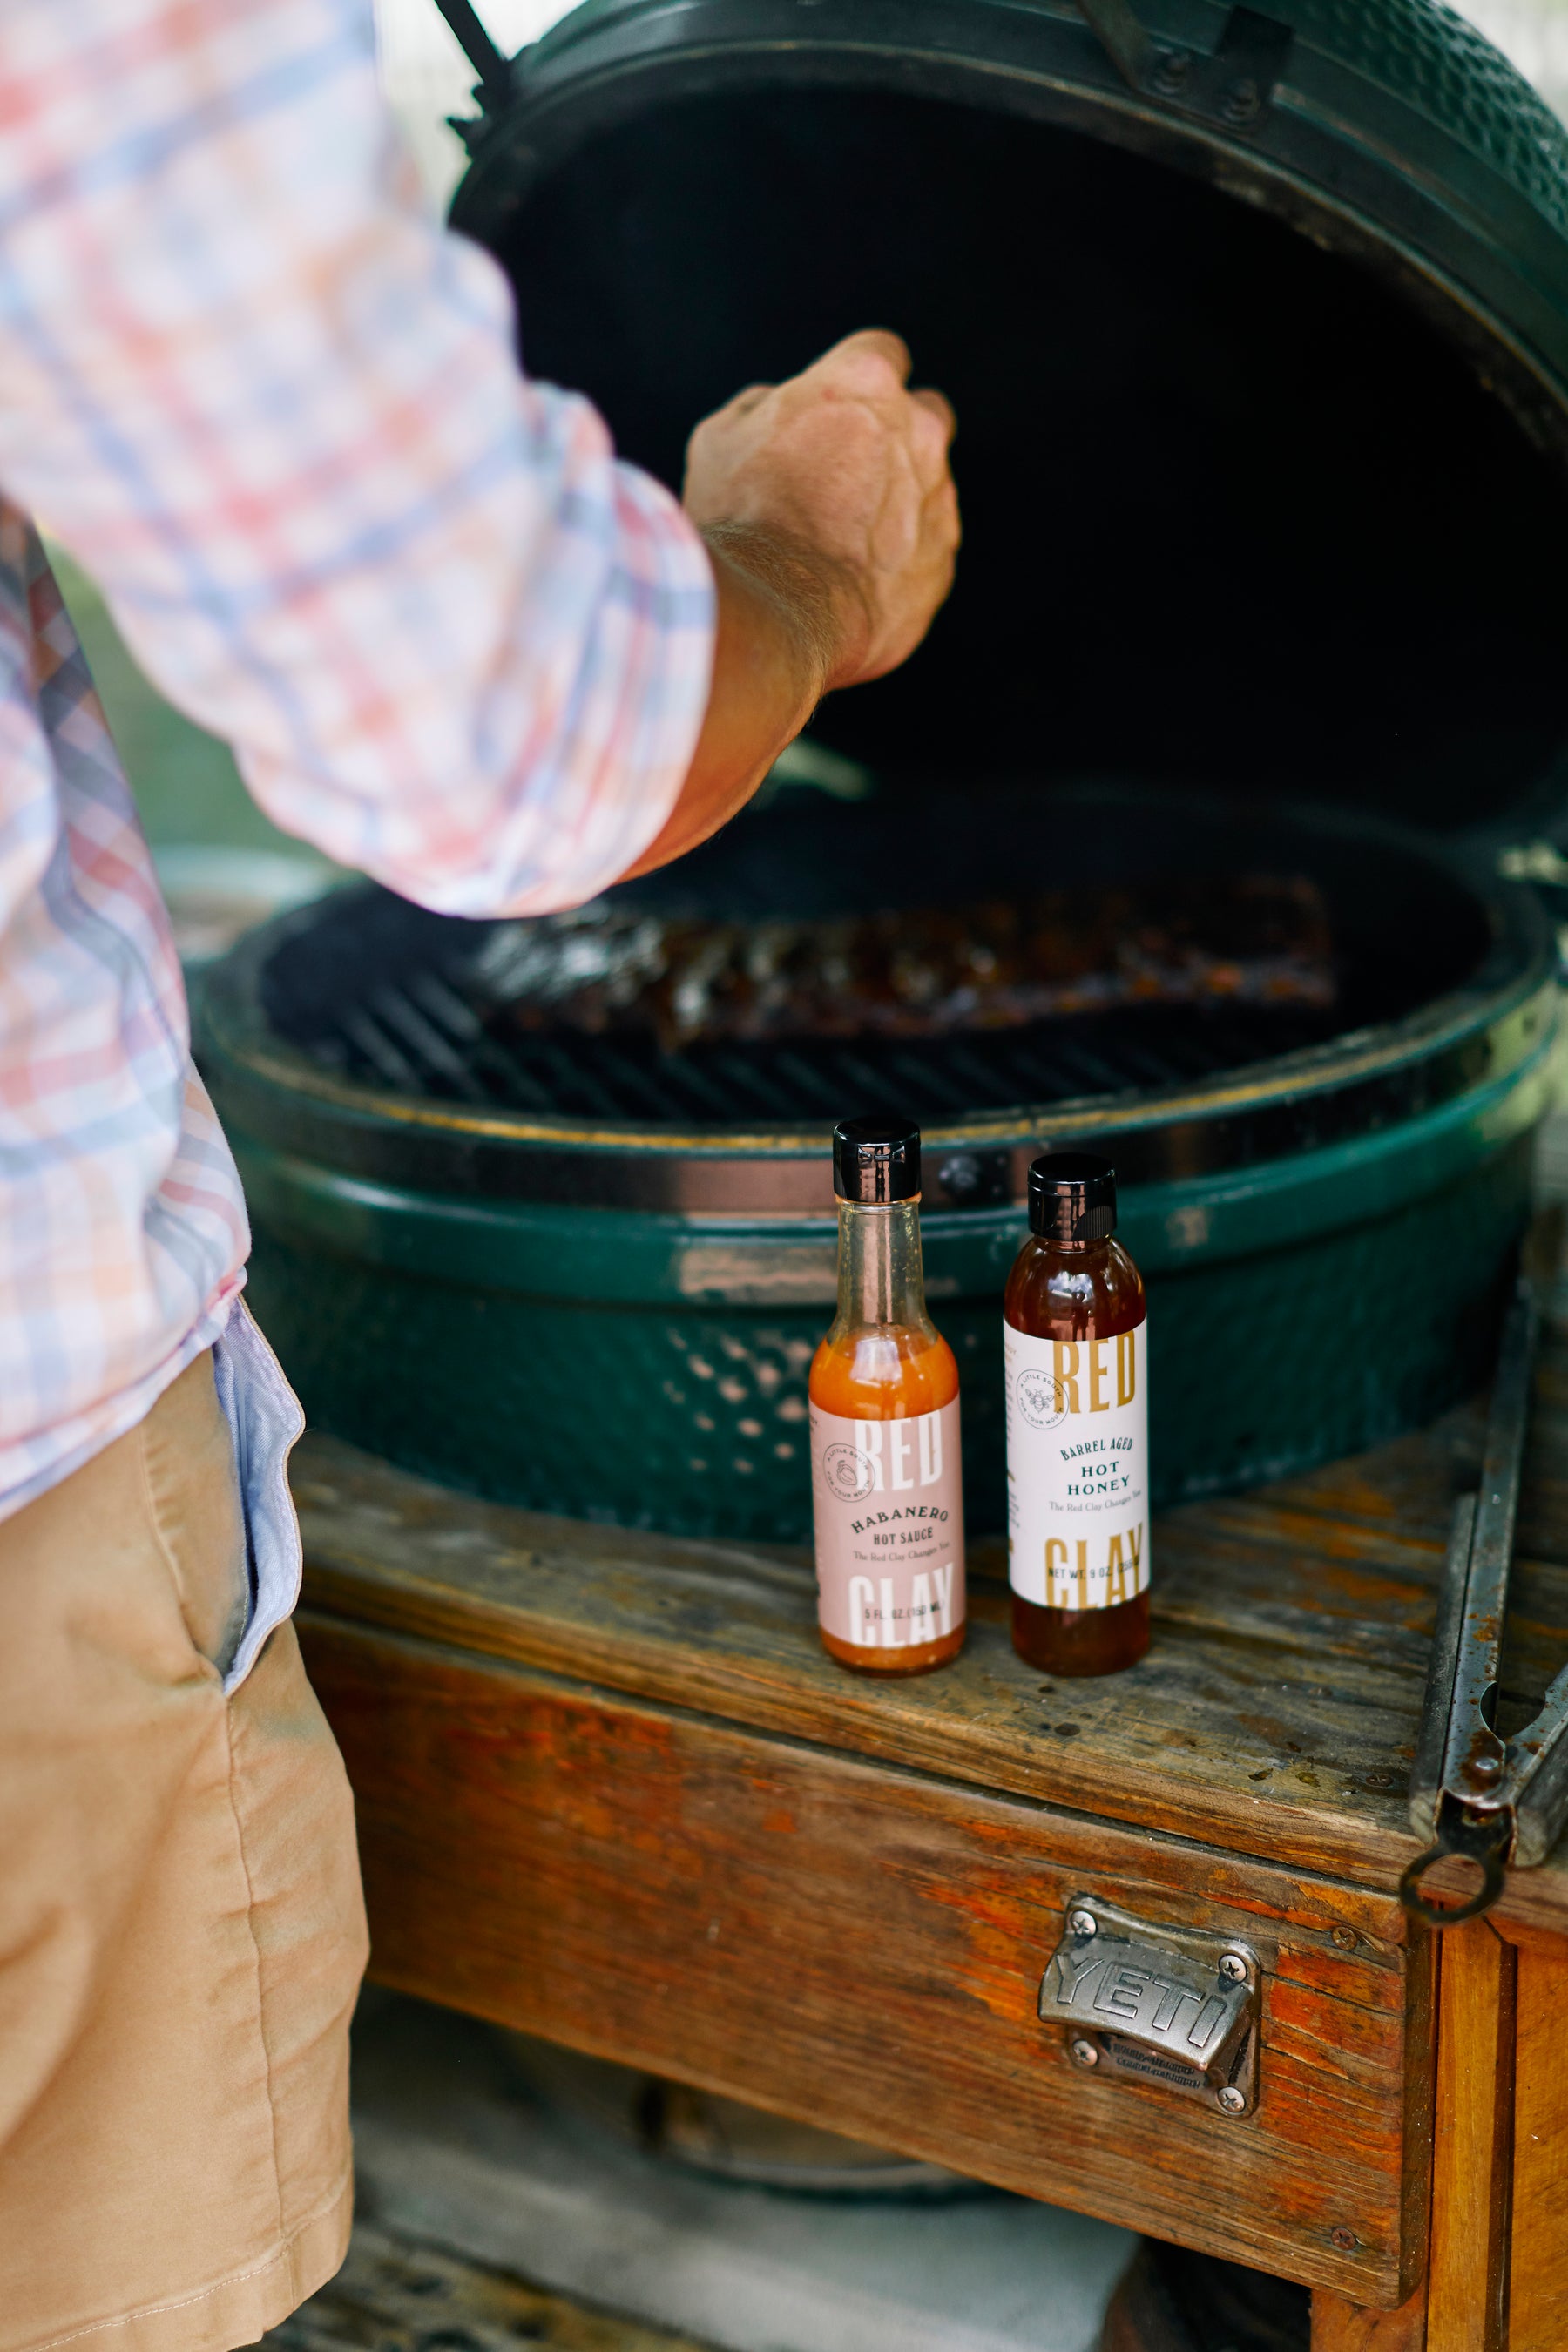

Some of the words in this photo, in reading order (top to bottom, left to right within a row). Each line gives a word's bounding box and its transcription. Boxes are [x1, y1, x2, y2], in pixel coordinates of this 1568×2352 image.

[1053, 1328, 1135, 1414] RED
[1023, 1374, 1040, 1383] LITTLE
[1043, 1377, 1062, 1396] SOUTH
[1028, 1414, 1044, 1425] YOUR
[1045, 1407, 1064, 1425] MOUTH
[830, 1448, 848, 1457] LITTLE
[849, 1450, 868, 1470] SOUTH
[855, 1409, 943, 1491] RED
[1060, 1438, 1106, 1461] BARREL
[1110, 1436, 1133, 1450] AGED
[1081, 1461, 1119, 1477] HOT
[835, 1487, 851, 1497] YOUR
[853, 1480, 870, 1497] MOUTH
[1067, 1474, 1130, 1496] HONEY
[1049, 1501, 1064, 1511] The
[1067, 1502, 1083, 1512] Red
[1085, 1502, 1102, 1512] Clay
[1105, 1496, 1132, 1509] Changes
[850, 1506, 949, 1534] HABANERO
[874, 1533, 896, 1545] HOT
[900, 1526, 934, 1544] SAUCE
[854, 1551, 868, 1561] The
[871, 1552, 886, 1562] Red
[889, 1552, 905, 1562] Clay
[908, 1546, 937, 1559] Changes
[1044, 1522, 1143, 1610] CLAY
[1048, 1567, 1065, 1578] NET
[1069, 1569, 1085, 1580] WT.
[1090, 1568, 1096, 1578] 9
[848, 1562, 954, 1649] CLAY
[865, 1609, 871, 1619] 5
[1055, 1953, 1227, 2048] YETI
